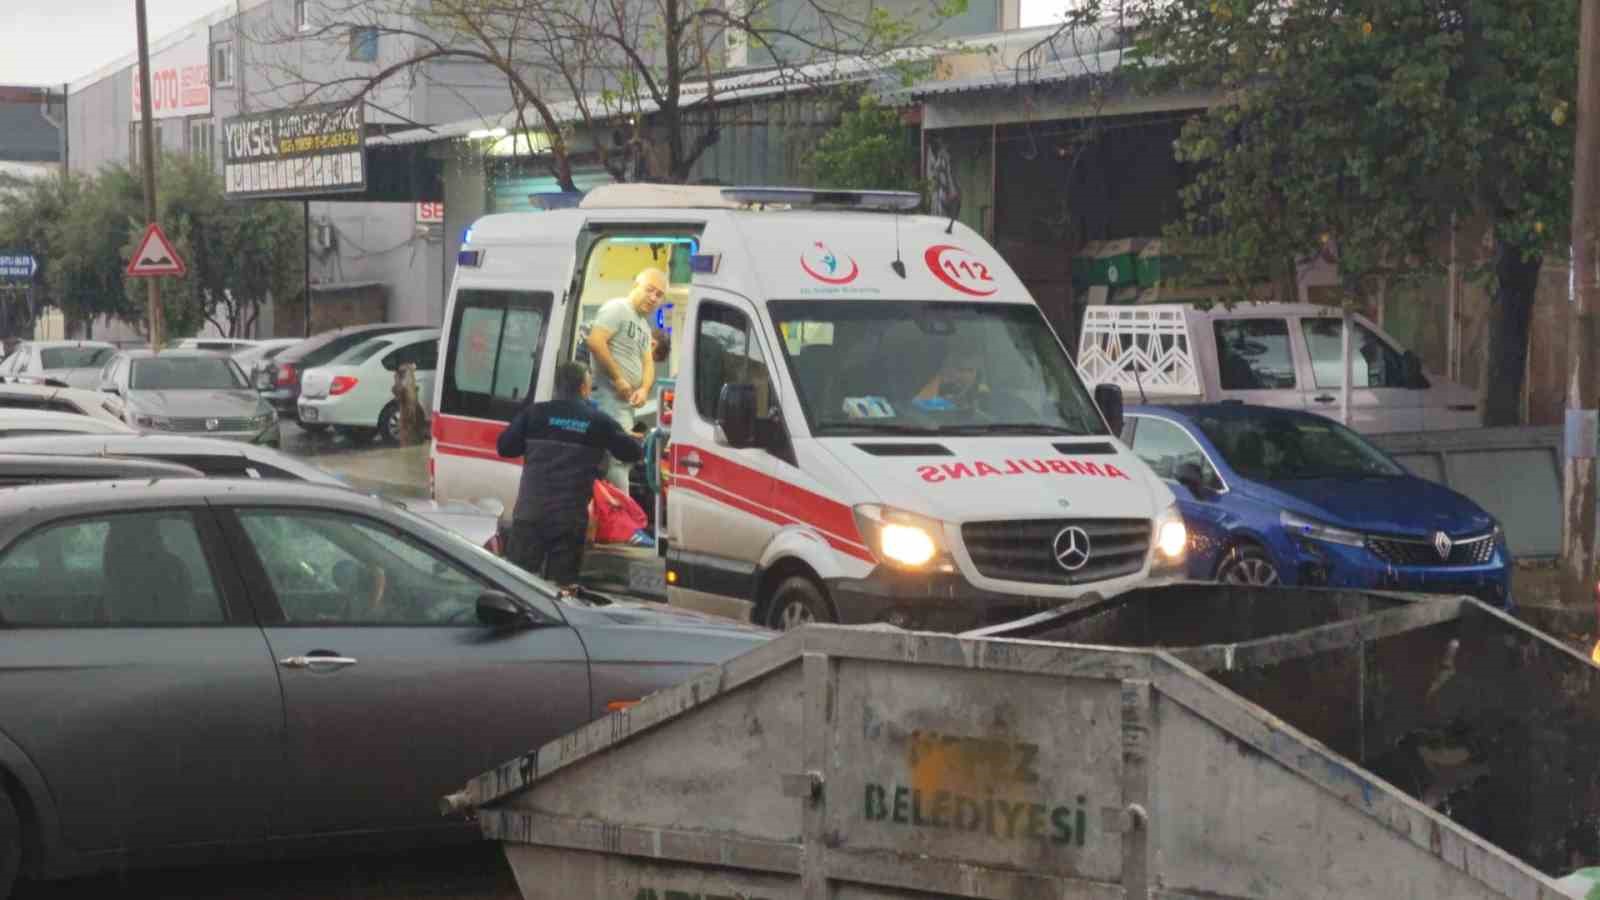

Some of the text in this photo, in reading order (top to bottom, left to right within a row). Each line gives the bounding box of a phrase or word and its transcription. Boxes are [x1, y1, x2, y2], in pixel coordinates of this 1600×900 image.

[153, 68, 178, 110] OTO
[420, 202, 443, 218] SE
[944, 258, 994, 281] 112
